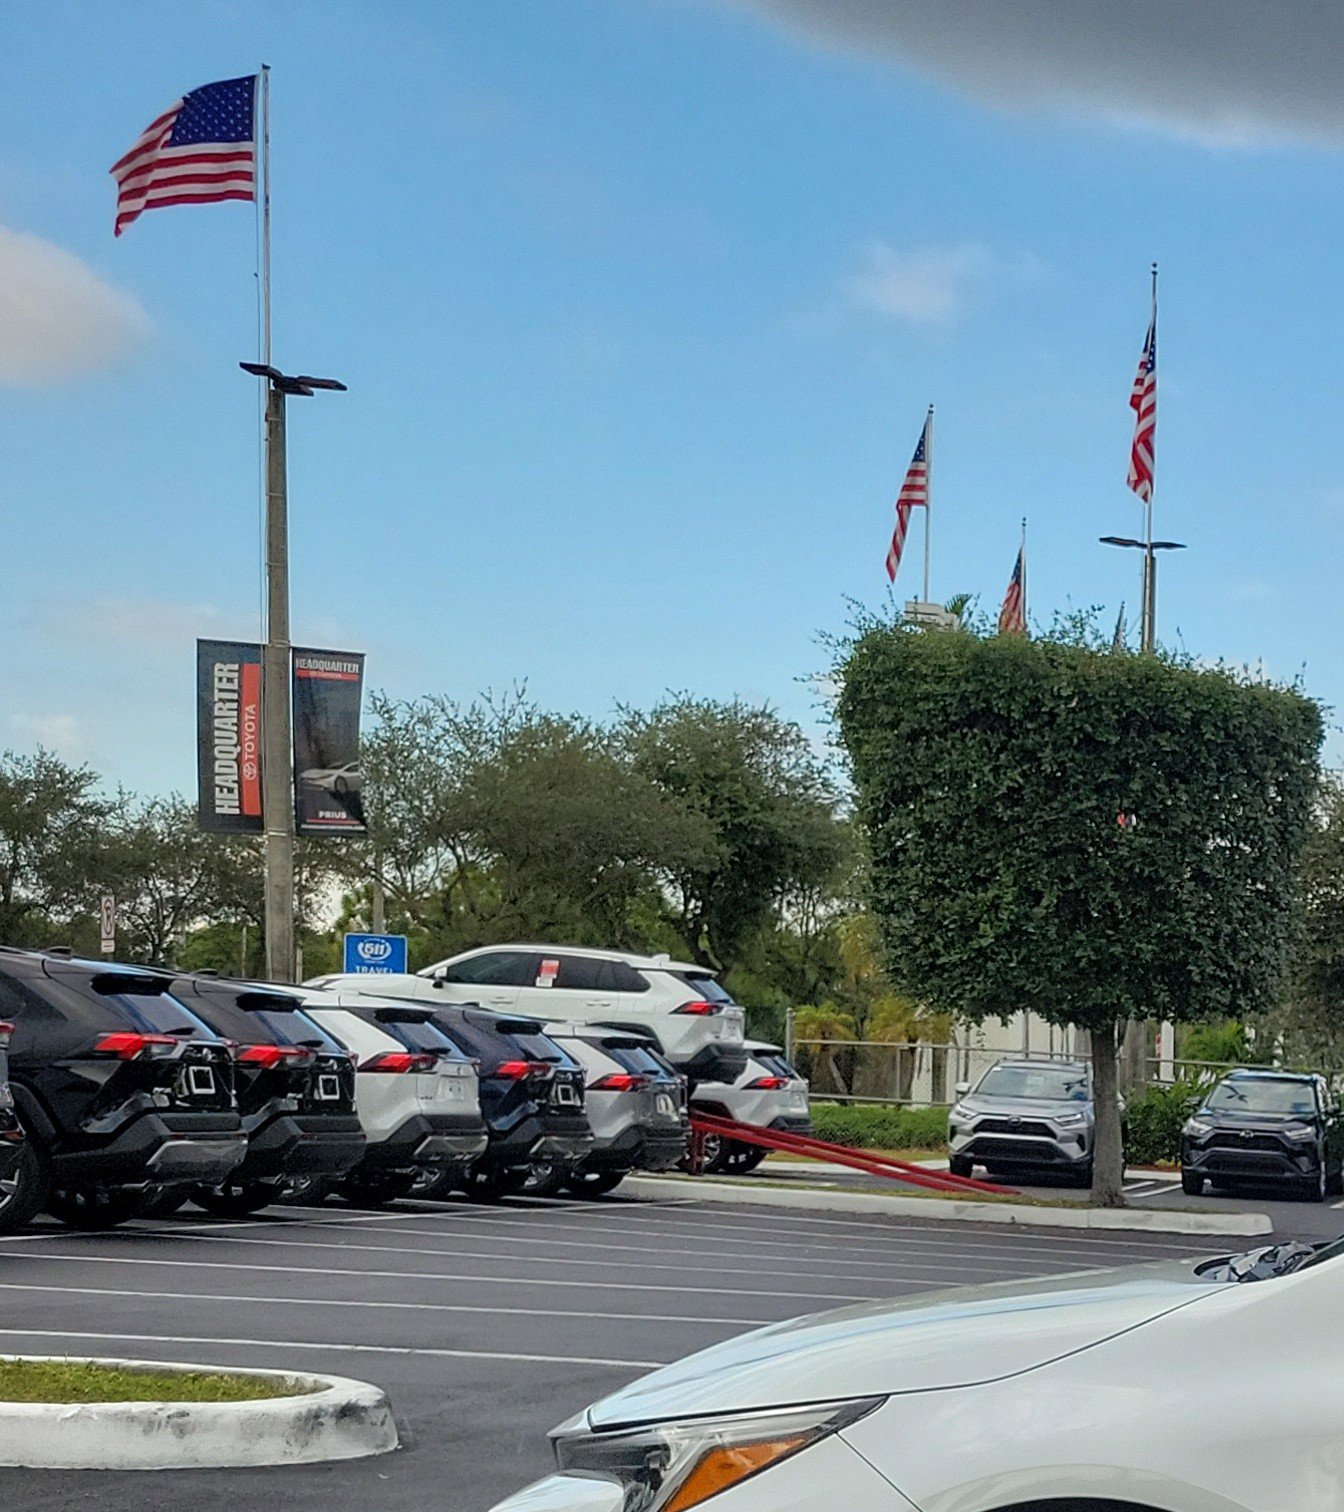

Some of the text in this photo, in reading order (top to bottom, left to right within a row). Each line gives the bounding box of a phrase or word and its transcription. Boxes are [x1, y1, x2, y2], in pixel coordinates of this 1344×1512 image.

[214, 662, 241, 815] HEADQUARTER
[244, 703, 256, 761] TOYOTA
[318, 810, 347, 819] PRIUS
[364, 942, 386, 955] 511
